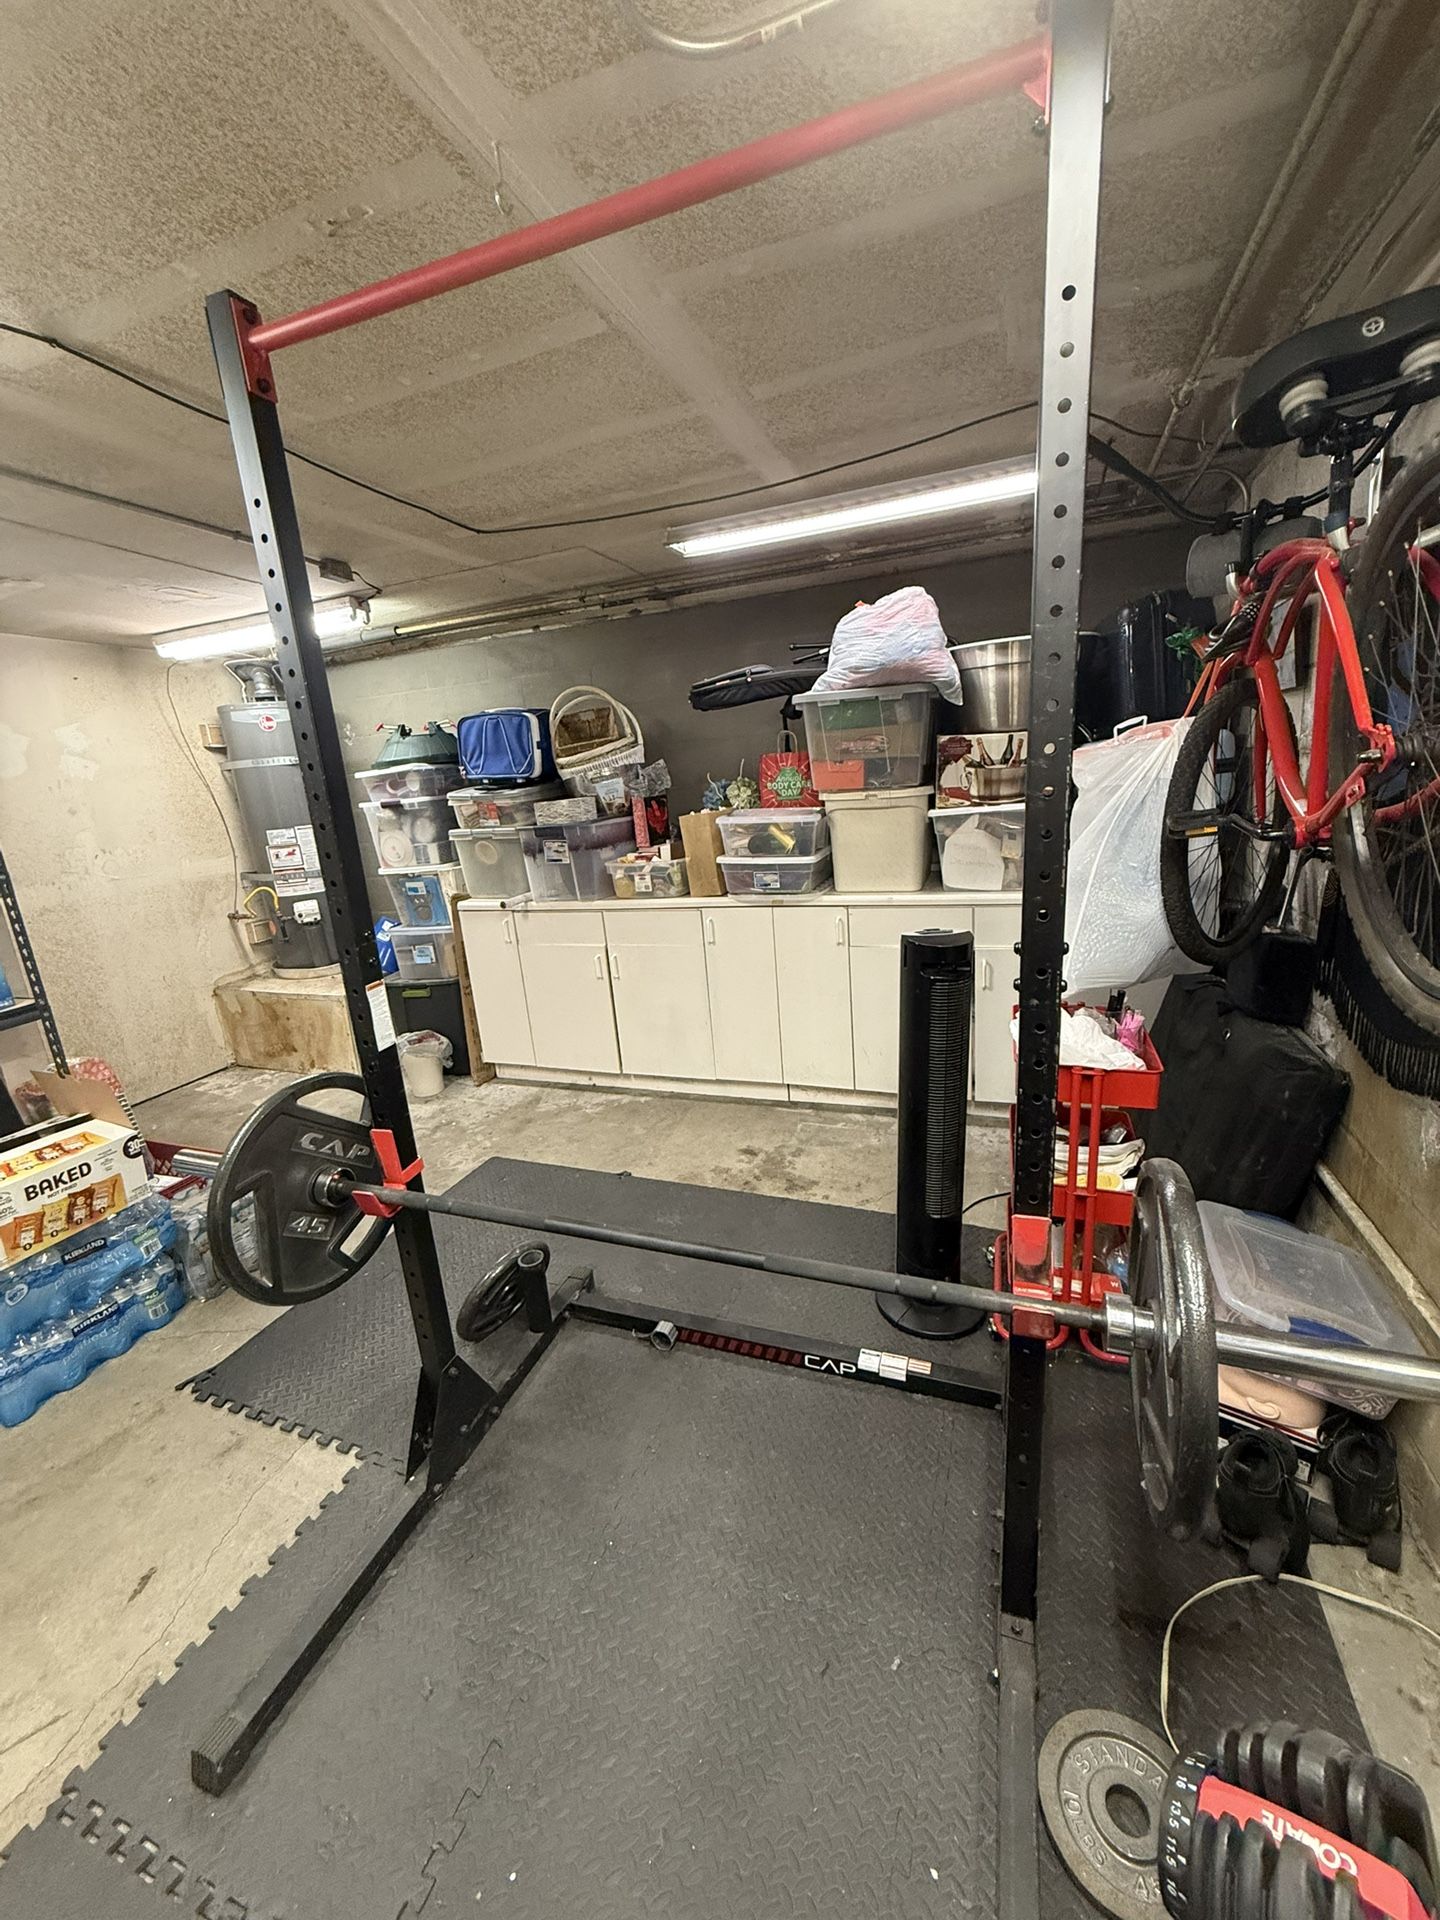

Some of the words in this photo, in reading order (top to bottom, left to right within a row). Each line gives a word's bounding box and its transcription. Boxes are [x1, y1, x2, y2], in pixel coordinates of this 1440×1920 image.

[767, 782, 789, 790] BODY
[781, 789, 798, 797] DAY
[300, 1132, 371, 1160] CAP
[23, 1161, 93, 1202] BAKED
[47, 1187, 61, 1199] NOT
[289, 1215, 330, 1234] 45
[64, 1239, 106, 1261] KIRKLAND
[804, 1354, 857, 1375] CAP
[1175, 1775, 1188, 1790] 16
[1168, 1799, 1182, 1830] 13.5
[1165, 1835, 1178, 1869] 11.5
[1166, 1877, 1178, 1898] 10
